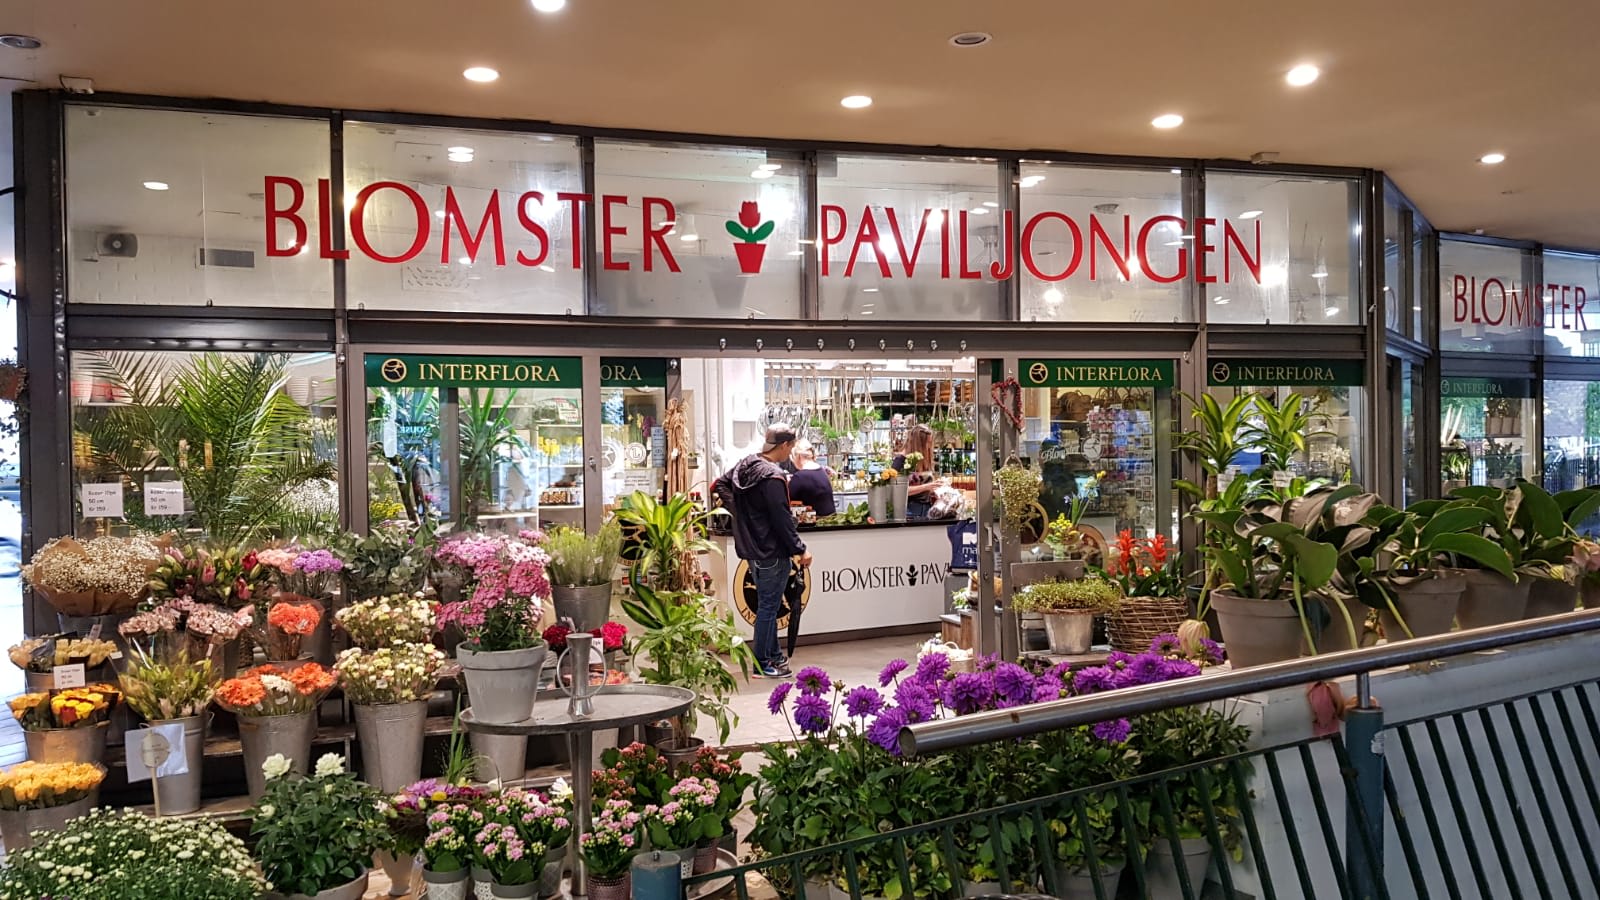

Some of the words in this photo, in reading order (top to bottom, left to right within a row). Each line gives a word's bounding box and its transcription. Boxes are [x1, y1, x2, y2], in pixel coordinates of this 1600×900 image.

[264, 175, 682, 273] BLOMSTER
[820, 204, 1262, 285] PAVILJONGEN
[1453, 274, 1588, 331] BLOMSTER
[418, 362, 561, 382] INTERFLORA
[1056, 366, 1163, 382] INTERFLORA
[1237, 366, 1335, 381] INTERFLORA
[1453, 382, 1503, 394] INTERFLORA
[822, 565, 905, 593] BLOMSTER
